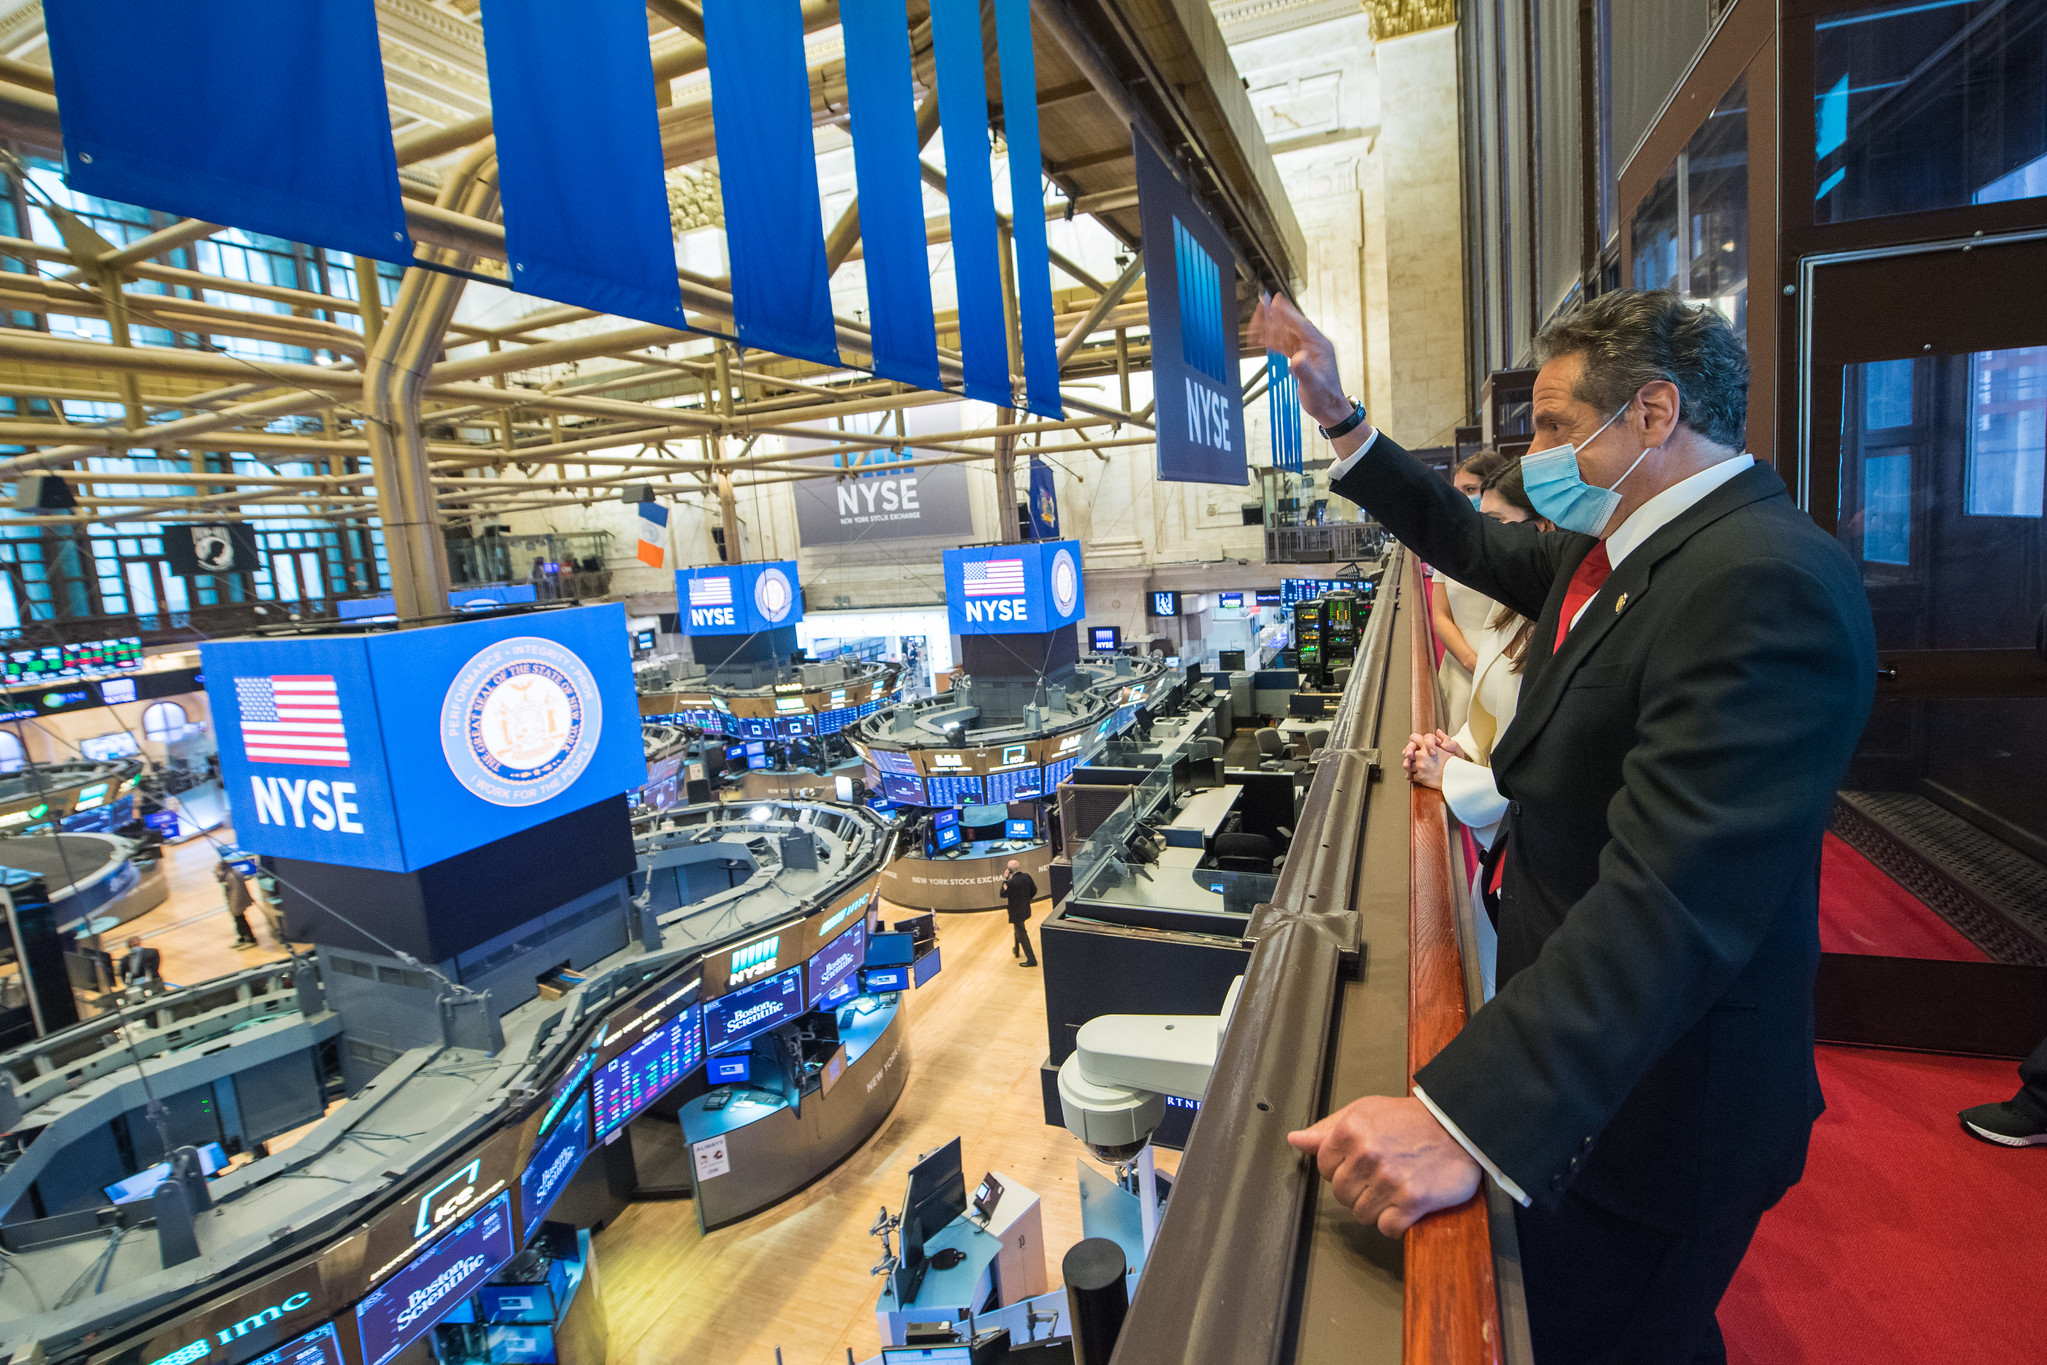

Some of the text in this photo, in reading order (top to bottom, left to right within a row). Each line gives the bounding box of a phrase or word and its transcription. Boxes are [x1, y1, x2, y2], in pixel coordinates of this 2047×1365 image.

[1185, 376, 1231, 452] NYSE
[837, 478, 920, 516] NYSE
[854, 515, 869, 523] YORK
[870, 514, 889, 522] STOCK
[889, 511, 921, 520] EXCHANGE
[691, 607, 736, 626] NYSE
[965, 599, 1028, 622] NYSE
[1096, 641, 1115, 649] NYSE
[449, 644, 594, 737] PERFORMANCE INTEGRITY PRIDE
[471, 663, 582, 773] THE GREAT SEAL OF THE STATE OF NEW YORK
[475, 778, 511, 800] WORK
[513, 787, 538, 800] FOR
[540, 776, 562, 794] THE
[561, 741, 593, 782] PEOPLE
[250, 775, 365, 834] NYSE
[911, 874, 1004, 886] NEW YORK STOCK EXCHA
[729, 956, 778, 986] NYSE
[726, 1000, 784, 1034] Scientific
[733, 1000, 771, 1021] Boston
[866, 1068, 883, 1093] NEW
[695, 1140, 724, 1152] ALWAYS
[396, 1253, 485, 1333] Scientific
[406, 1257, 467, 1310] Boston
[216, 1291, 312, 1346] imc
